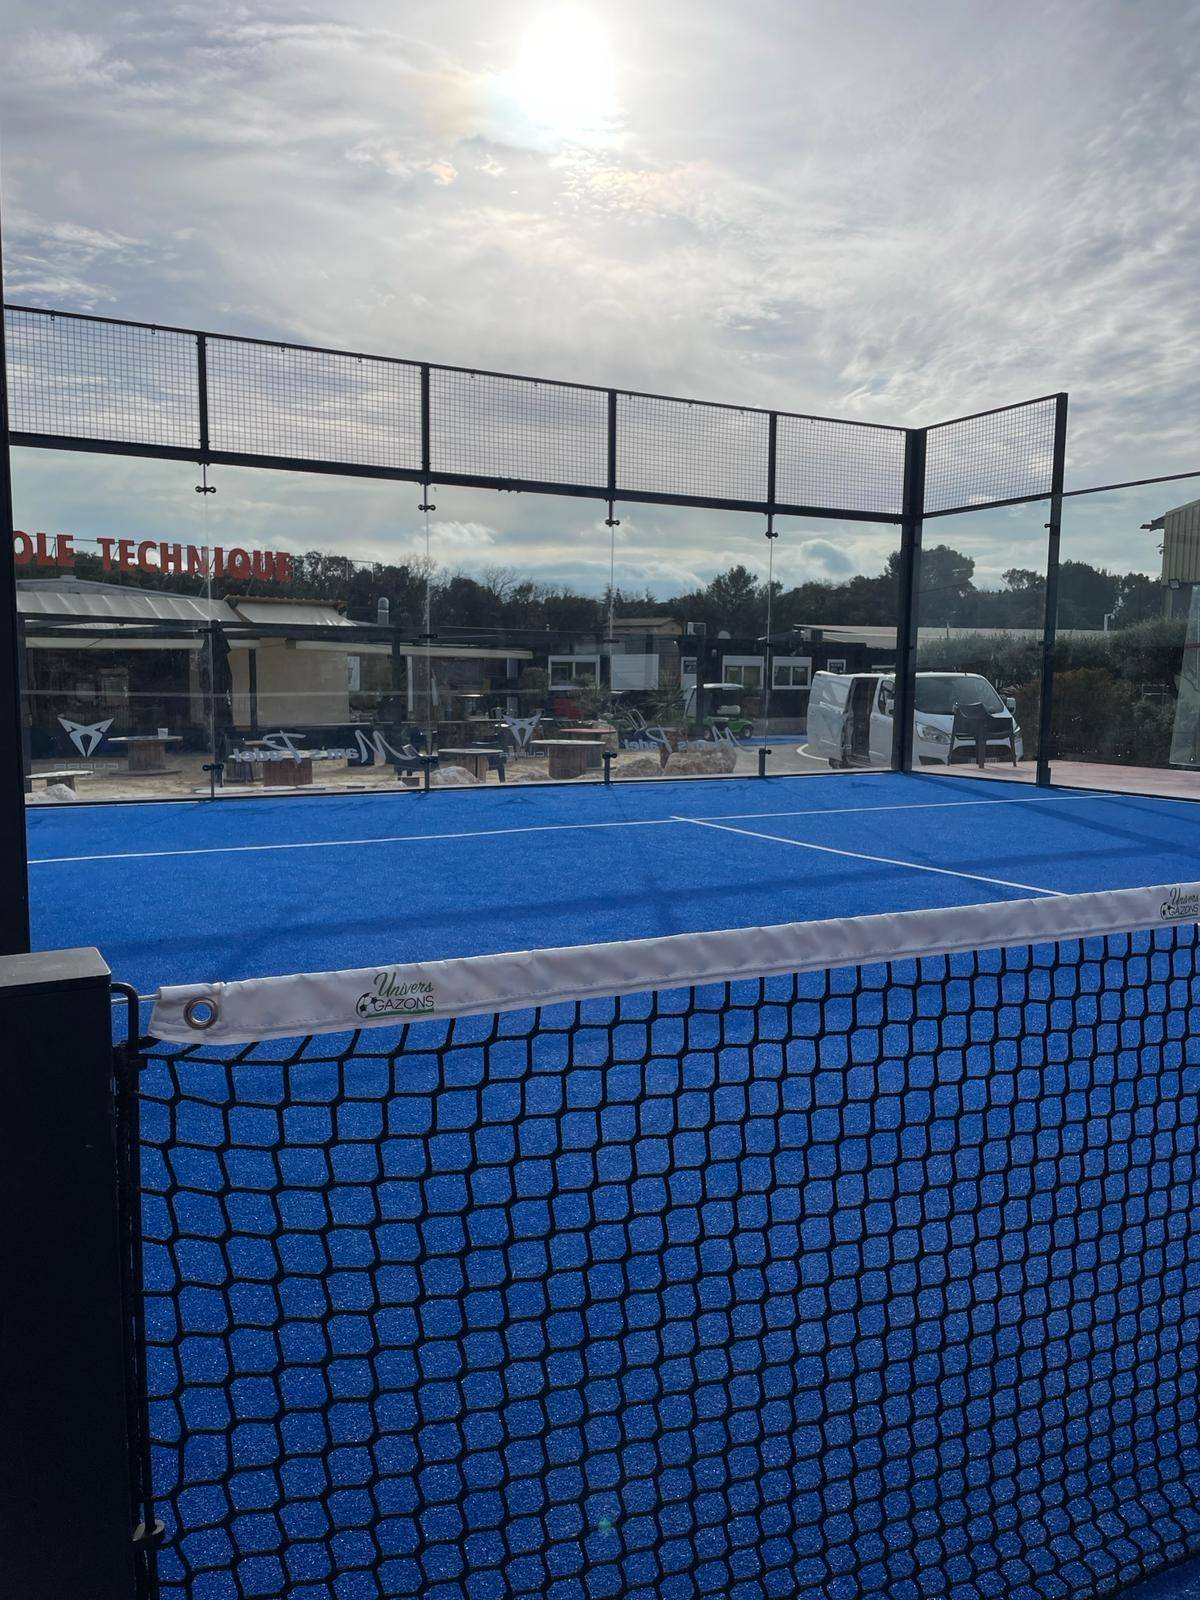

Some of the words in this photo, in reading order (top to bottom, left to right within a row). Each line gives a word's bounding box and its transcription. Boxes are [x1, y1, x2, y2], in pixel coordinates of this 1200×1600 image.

[97, 537, 293, 582] TECHNIQUE
[373, 972, 434, 997] Univers
[373, 995, 434, 1011] GAZONS
